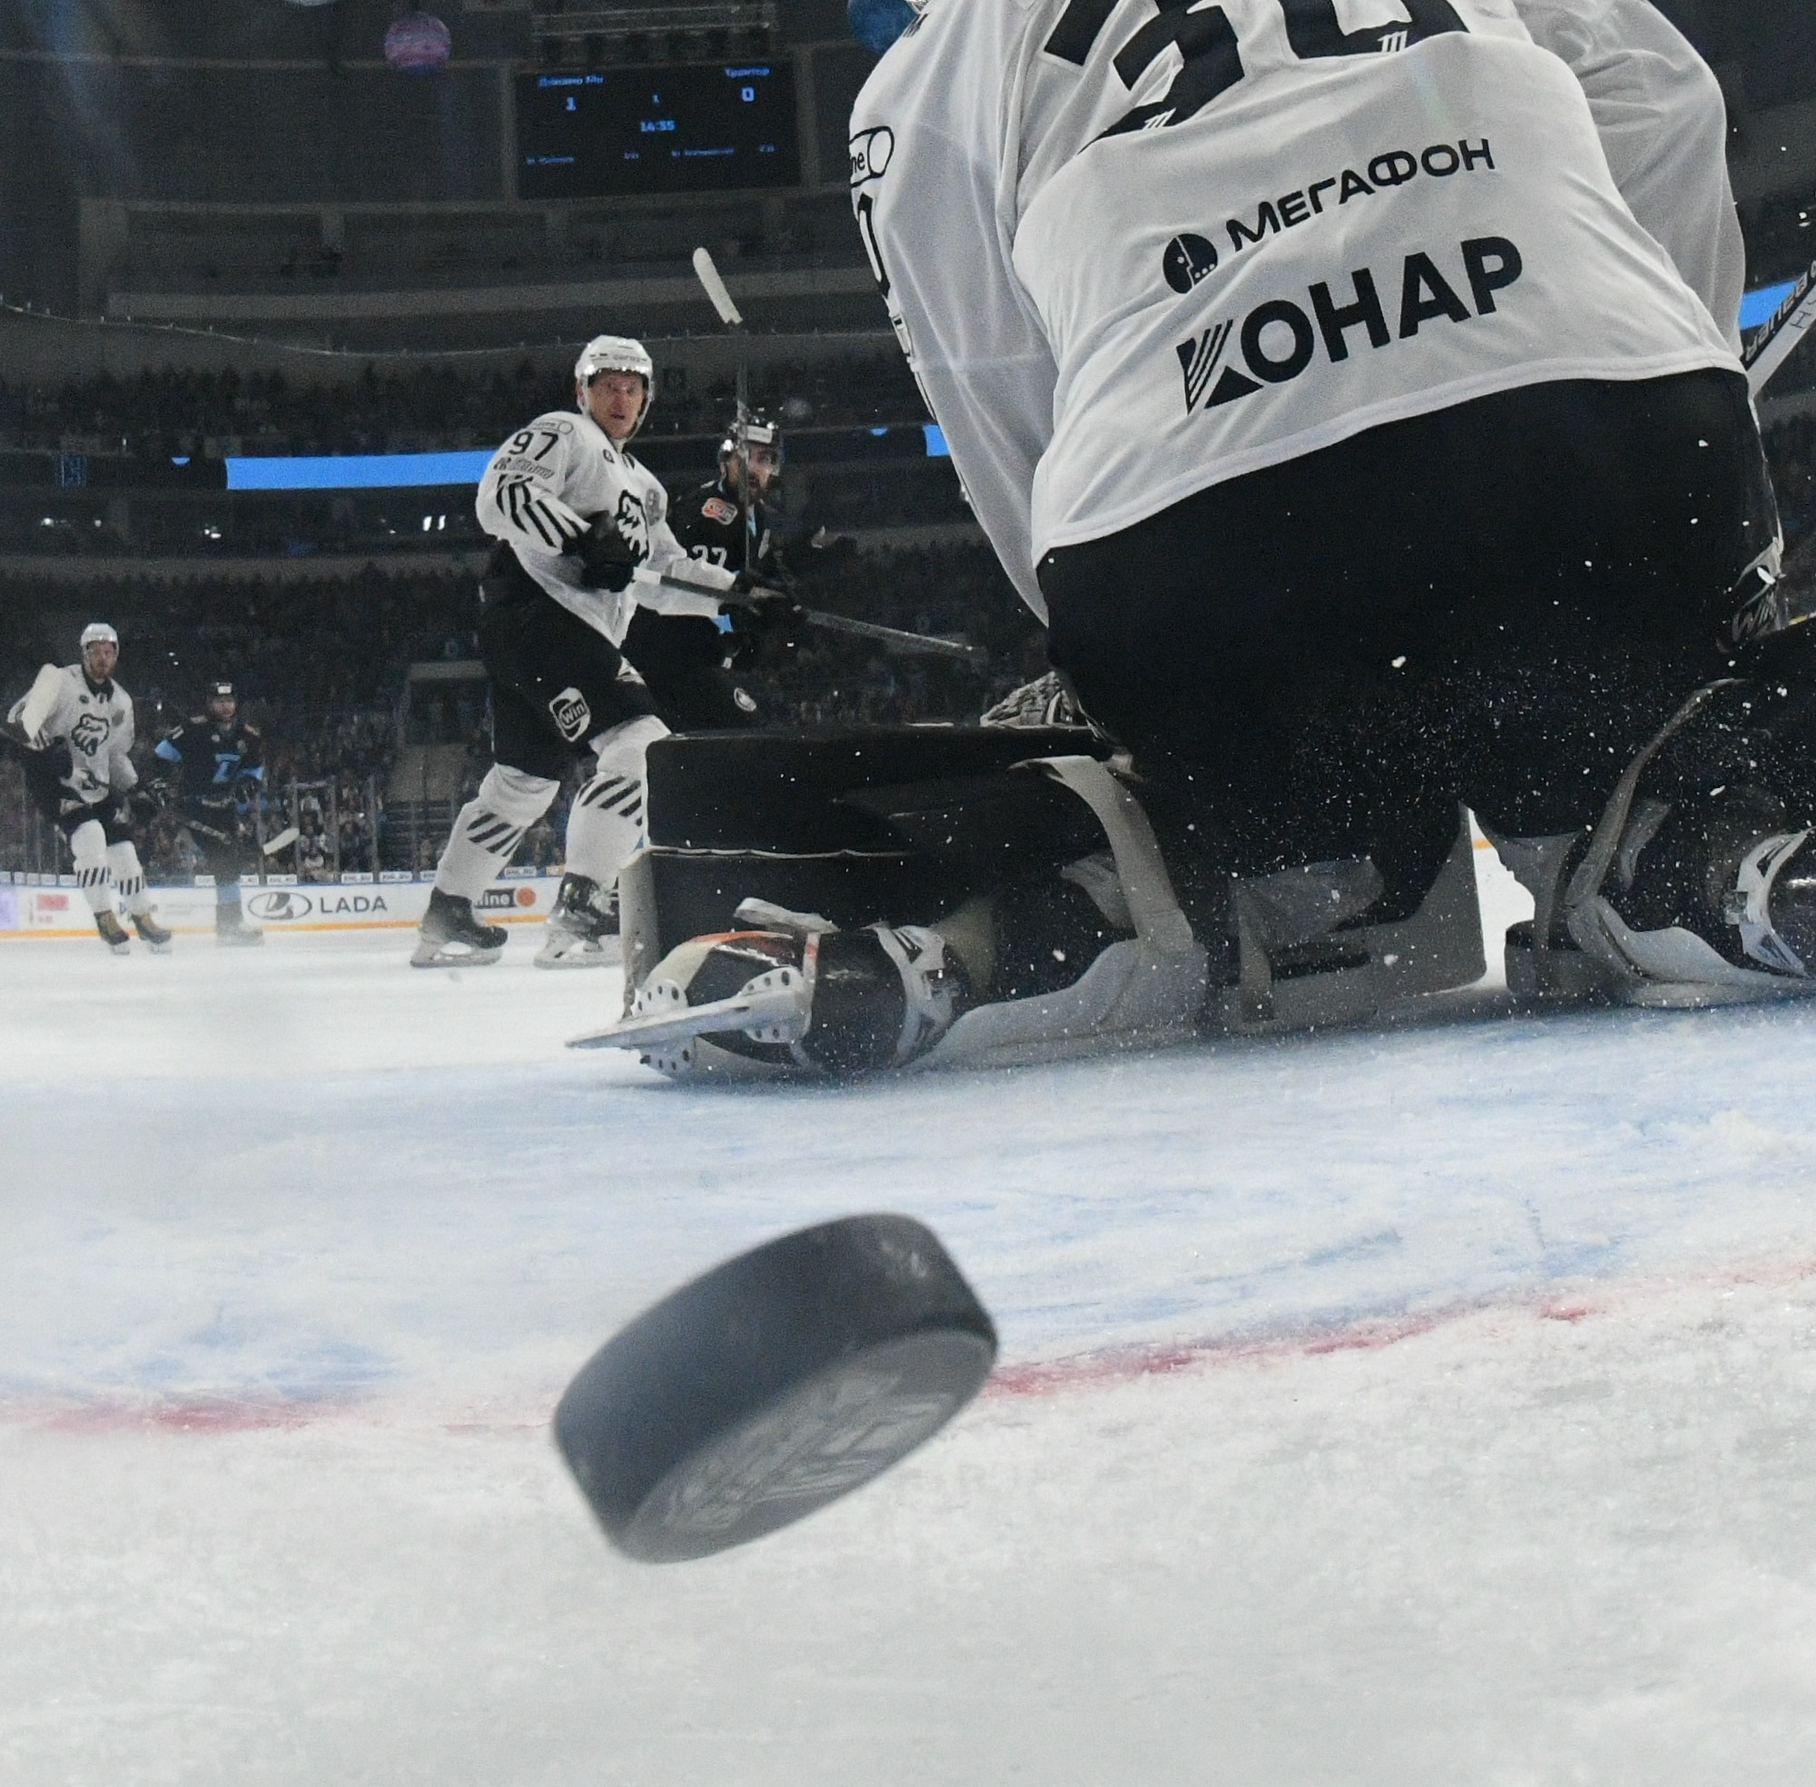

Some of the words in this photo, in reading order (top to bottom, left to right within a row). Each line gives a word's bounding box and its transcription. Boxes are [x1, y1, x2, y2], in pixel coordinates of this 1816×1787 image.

[741, 87, 755, 101] 0
[1226, 138, 1495, 252] МЕГАФОН
[1176, 236, 1523, 415] КОНАР
[508, 431, 559, 462] 97
[560, 701, 585, 724] Win
[320, 895, 388, 914] LADA
